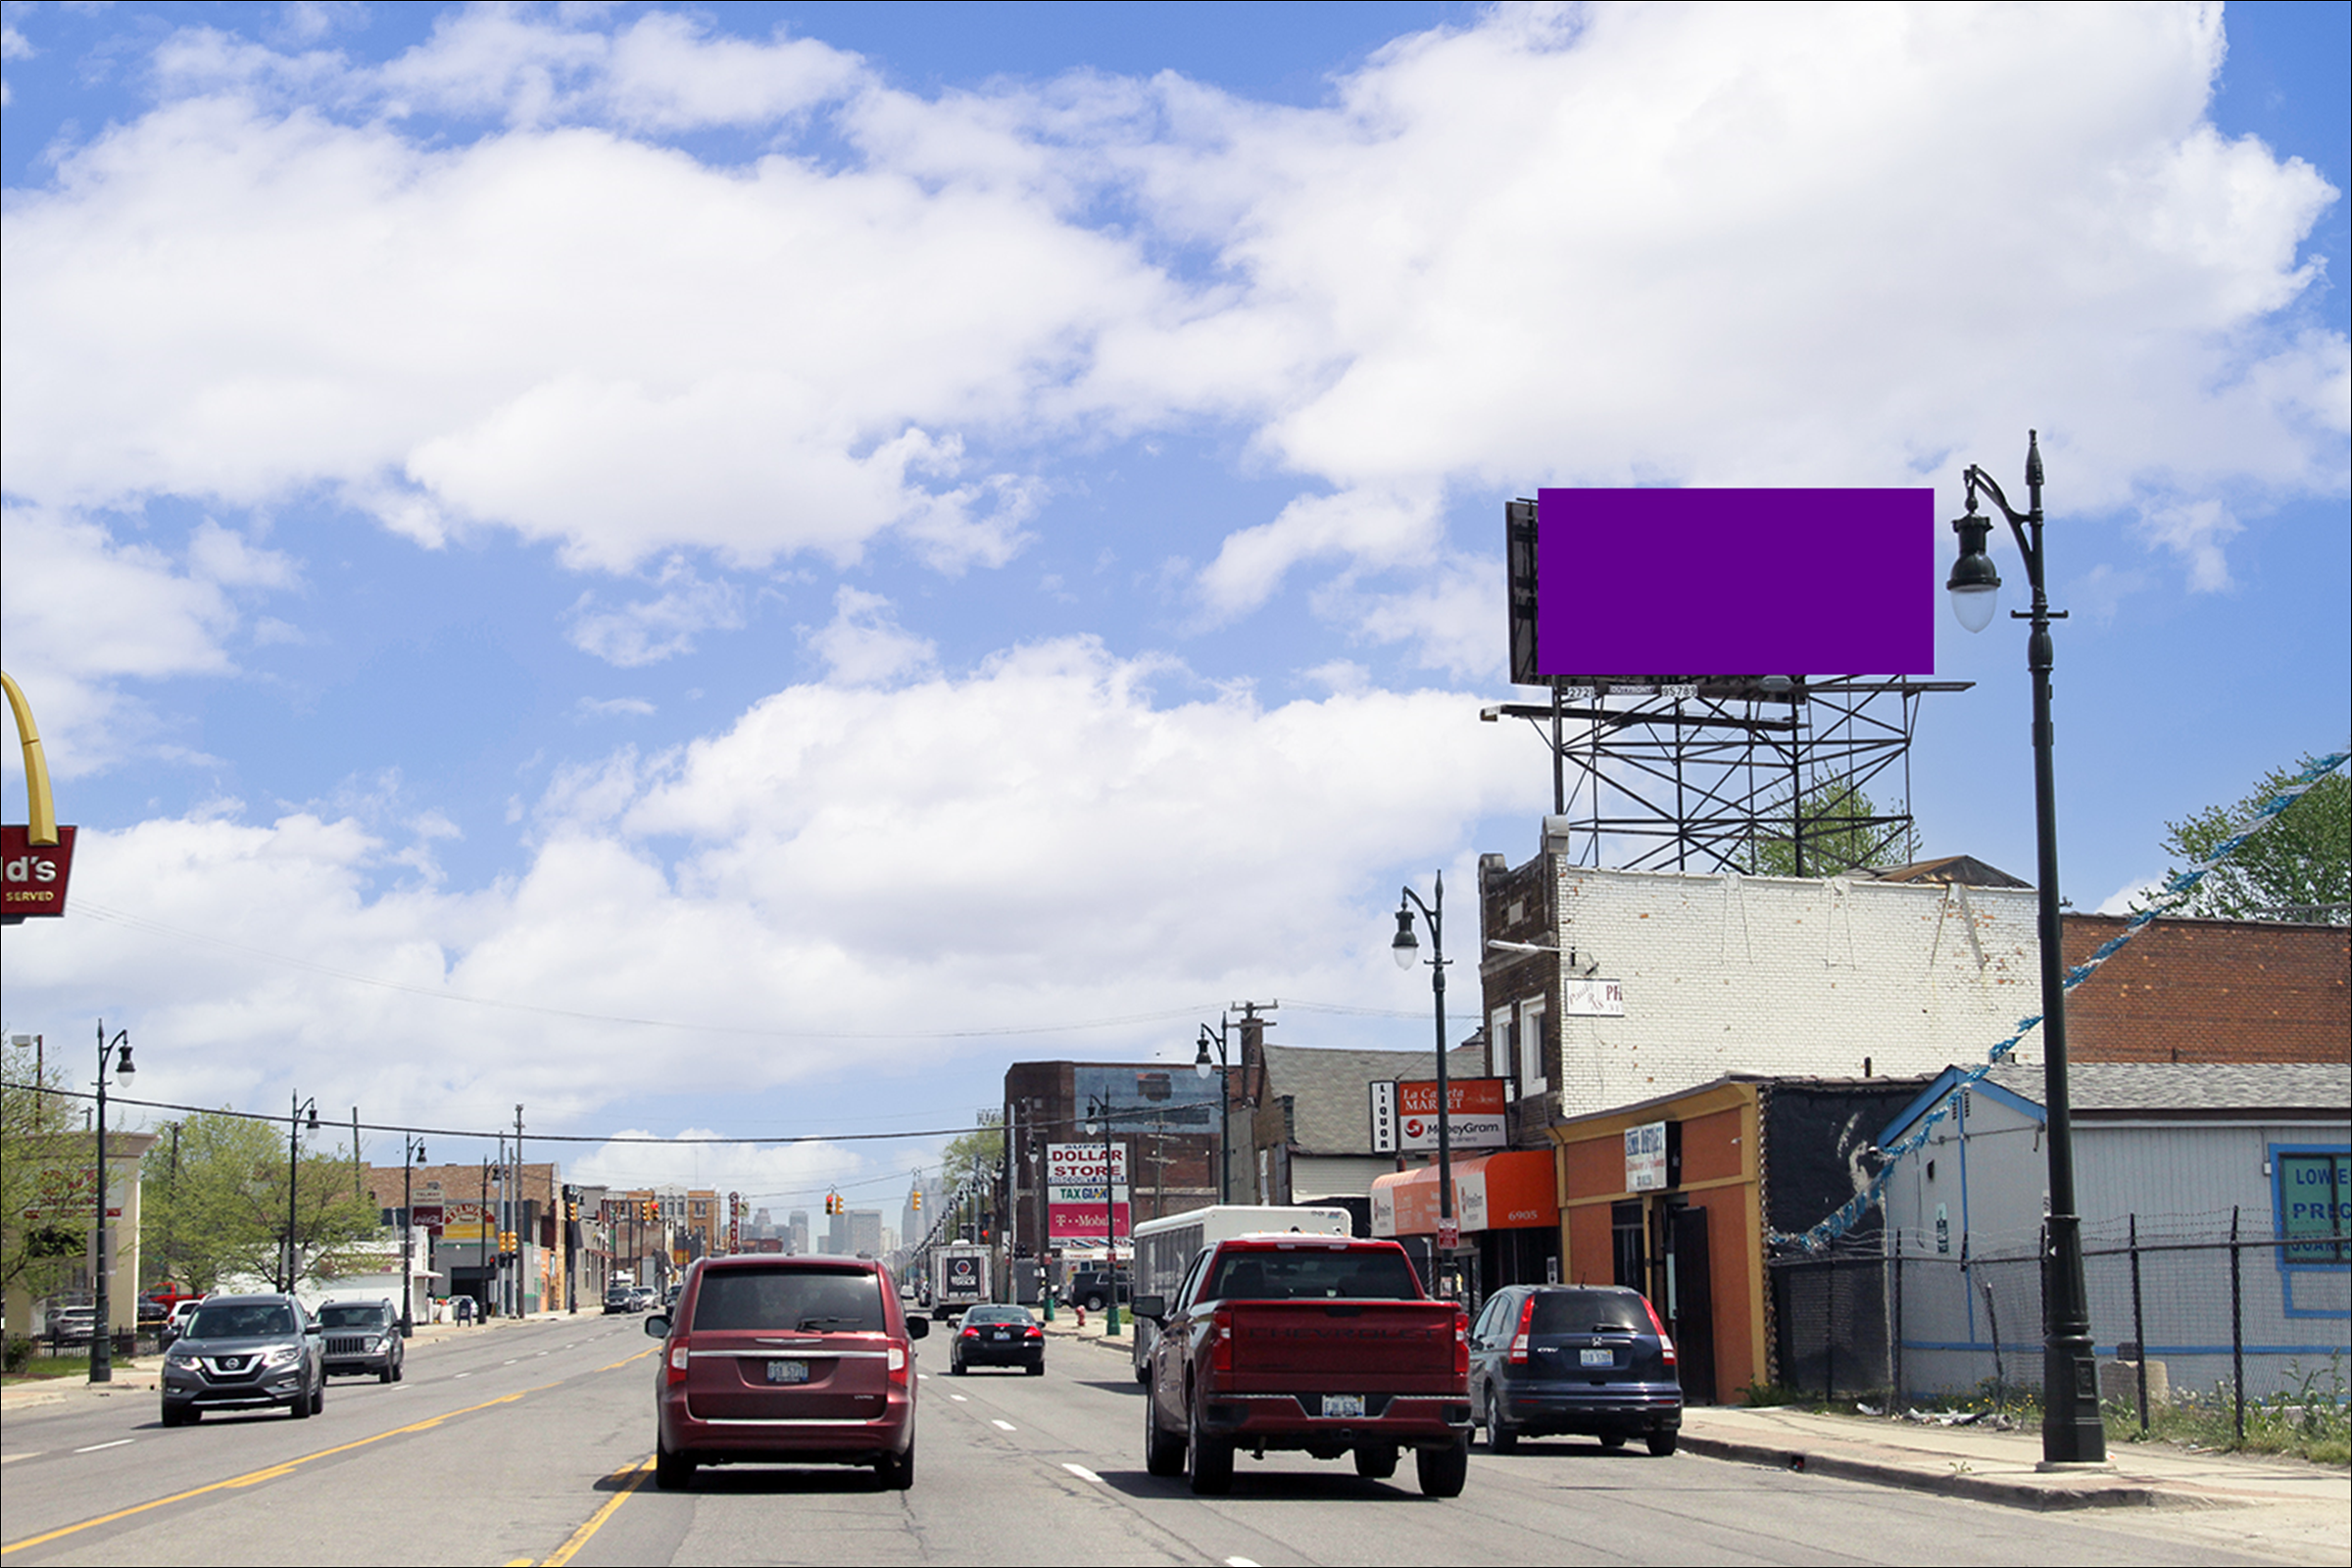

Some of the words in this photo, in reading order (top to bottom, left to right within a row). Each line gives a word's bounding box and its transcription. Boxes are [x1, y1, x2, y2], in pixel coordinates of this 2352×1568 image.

[1, 856, 57, 882] d's
[6, 891, 55, 902] SERVED
[1403, 1089, 1418, 1100] La
[1405, 1099, 1463, 1110] MARET
[1379, 1085, 1389, 1149] LIQUOR
[1053, 1151, 1123, 1161] DOLLAR
[1054, 1166, 1121, 1176] STORE
[2296, 1169, 2351, 1185] LOWE
[1060, 1189, 1080, 1199] TAX
[1082, 1188, 1113, 1200] GIAN
[1508, 1210, 1538, 1221] 6905
[1250, 1328, 1438, 1340] CHEVROLET
